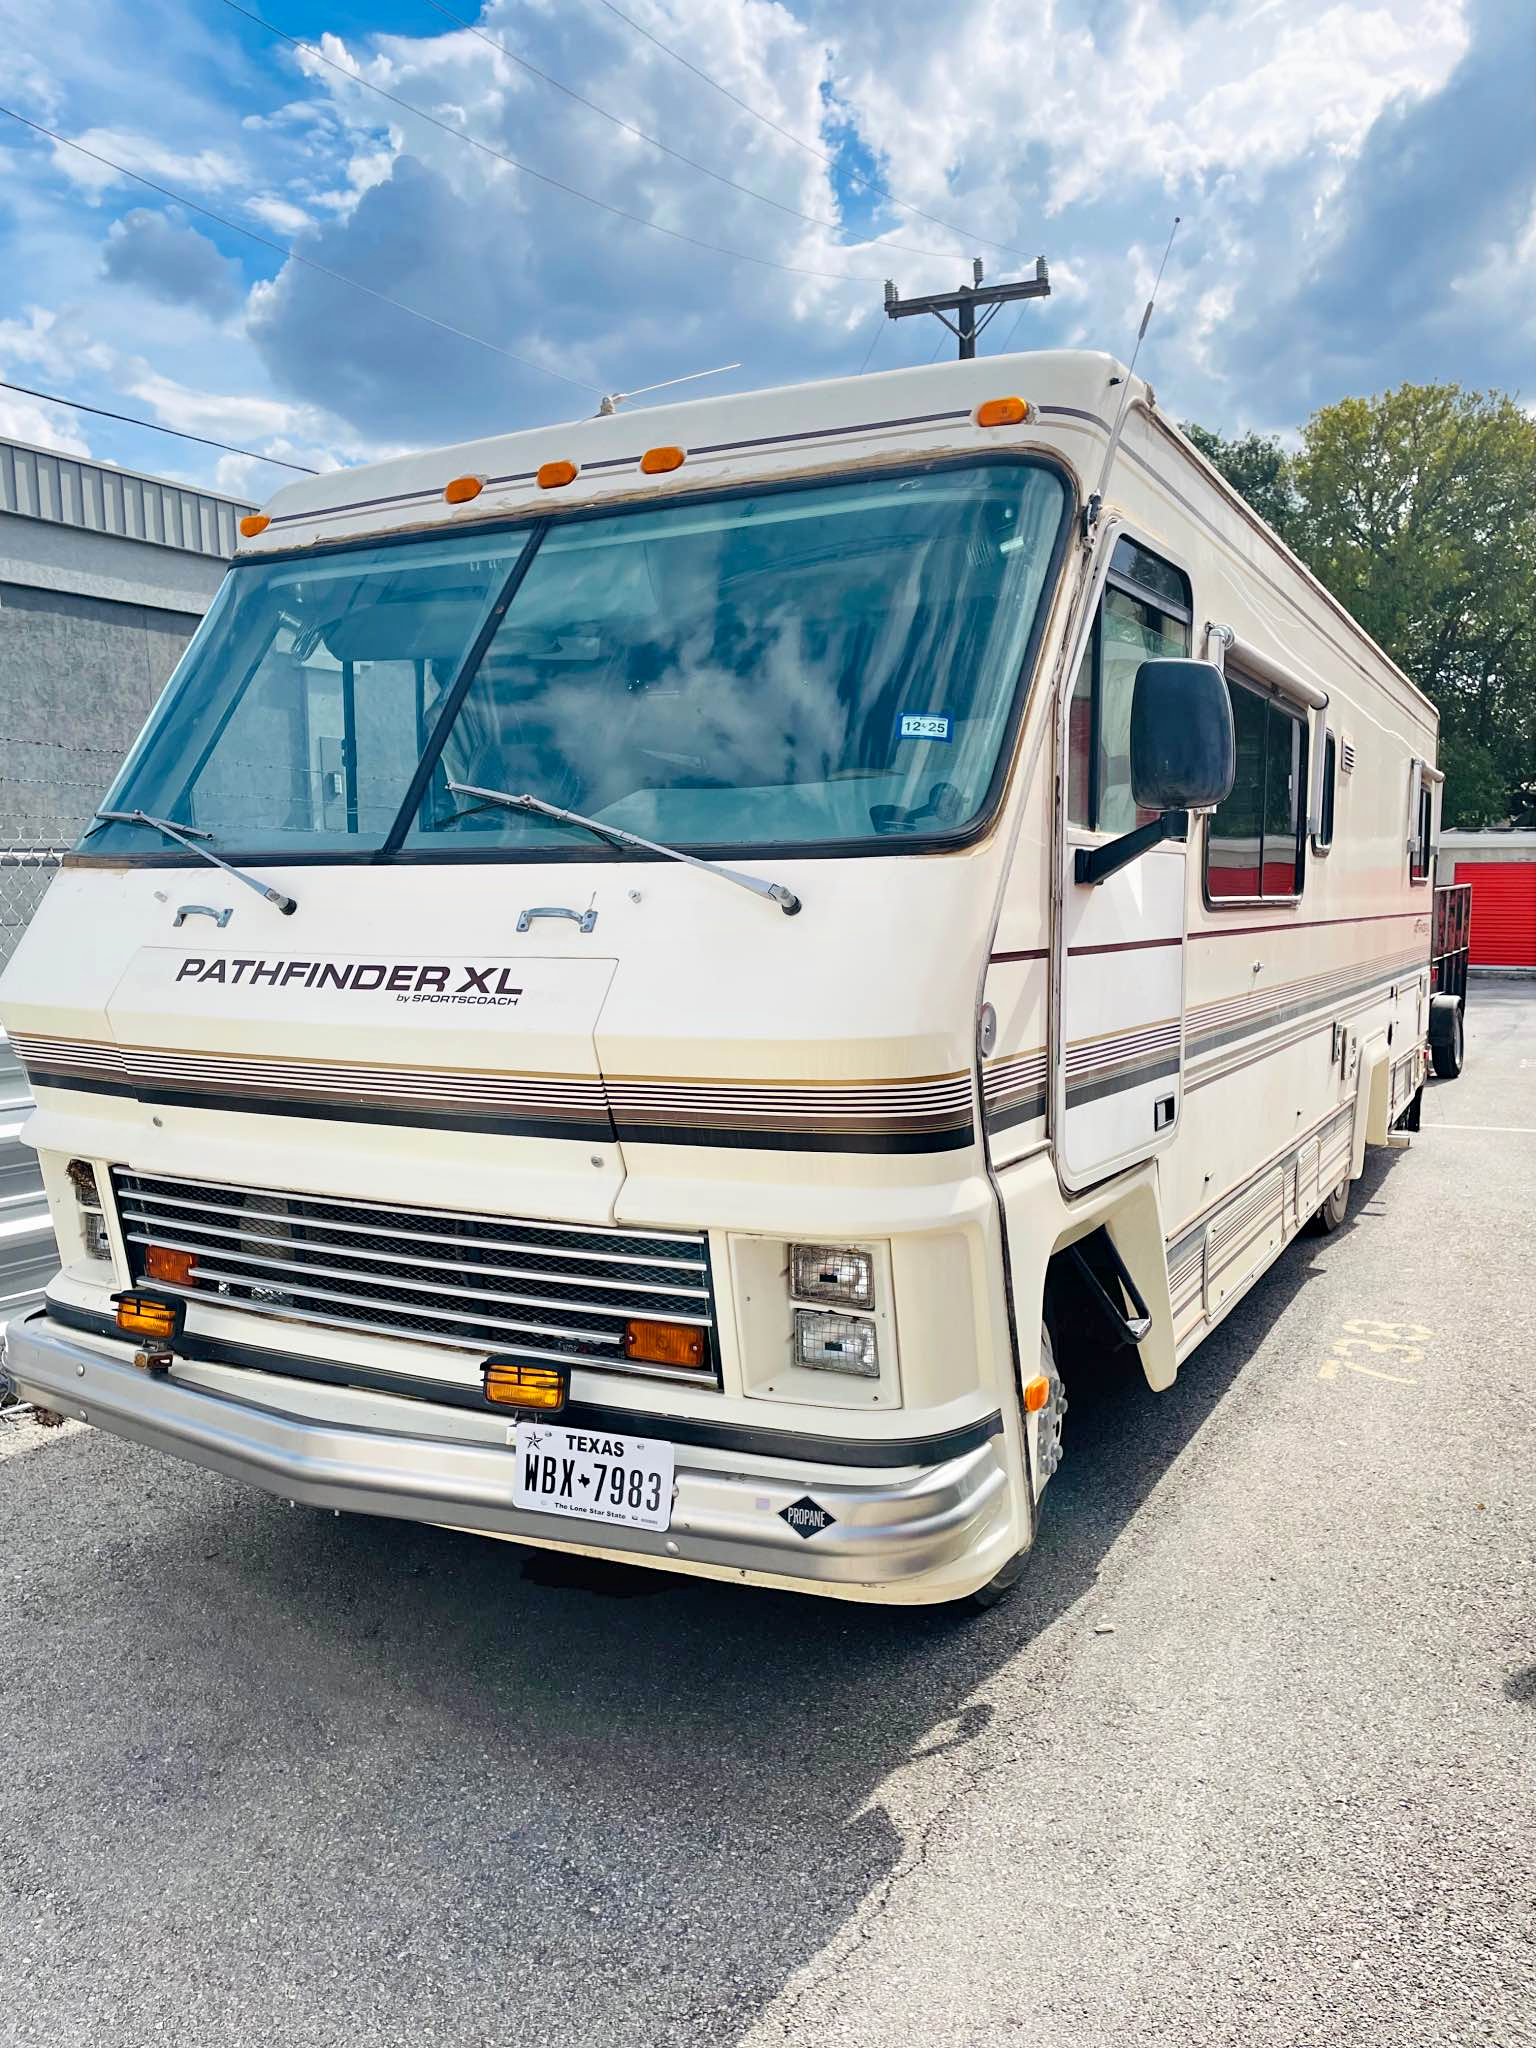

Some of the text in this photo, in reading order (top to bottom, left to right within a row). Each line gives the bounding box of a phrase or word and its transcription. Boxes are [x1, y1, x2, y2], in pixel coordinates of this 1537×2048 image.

[904, 721, 945, 733] 12 25
[175, 958, 523, 995] PATHFINDER XL
[396, 994, 519, 1006] by SPORTSCOACH
[565, 1434, 625, 1458] TEXAS
[524, 1453, 662, 1512] WBX 7983
[554, 1502, 626, 1520] The Lone Star State
[787, 1507, 826, 1528] PROPANE
